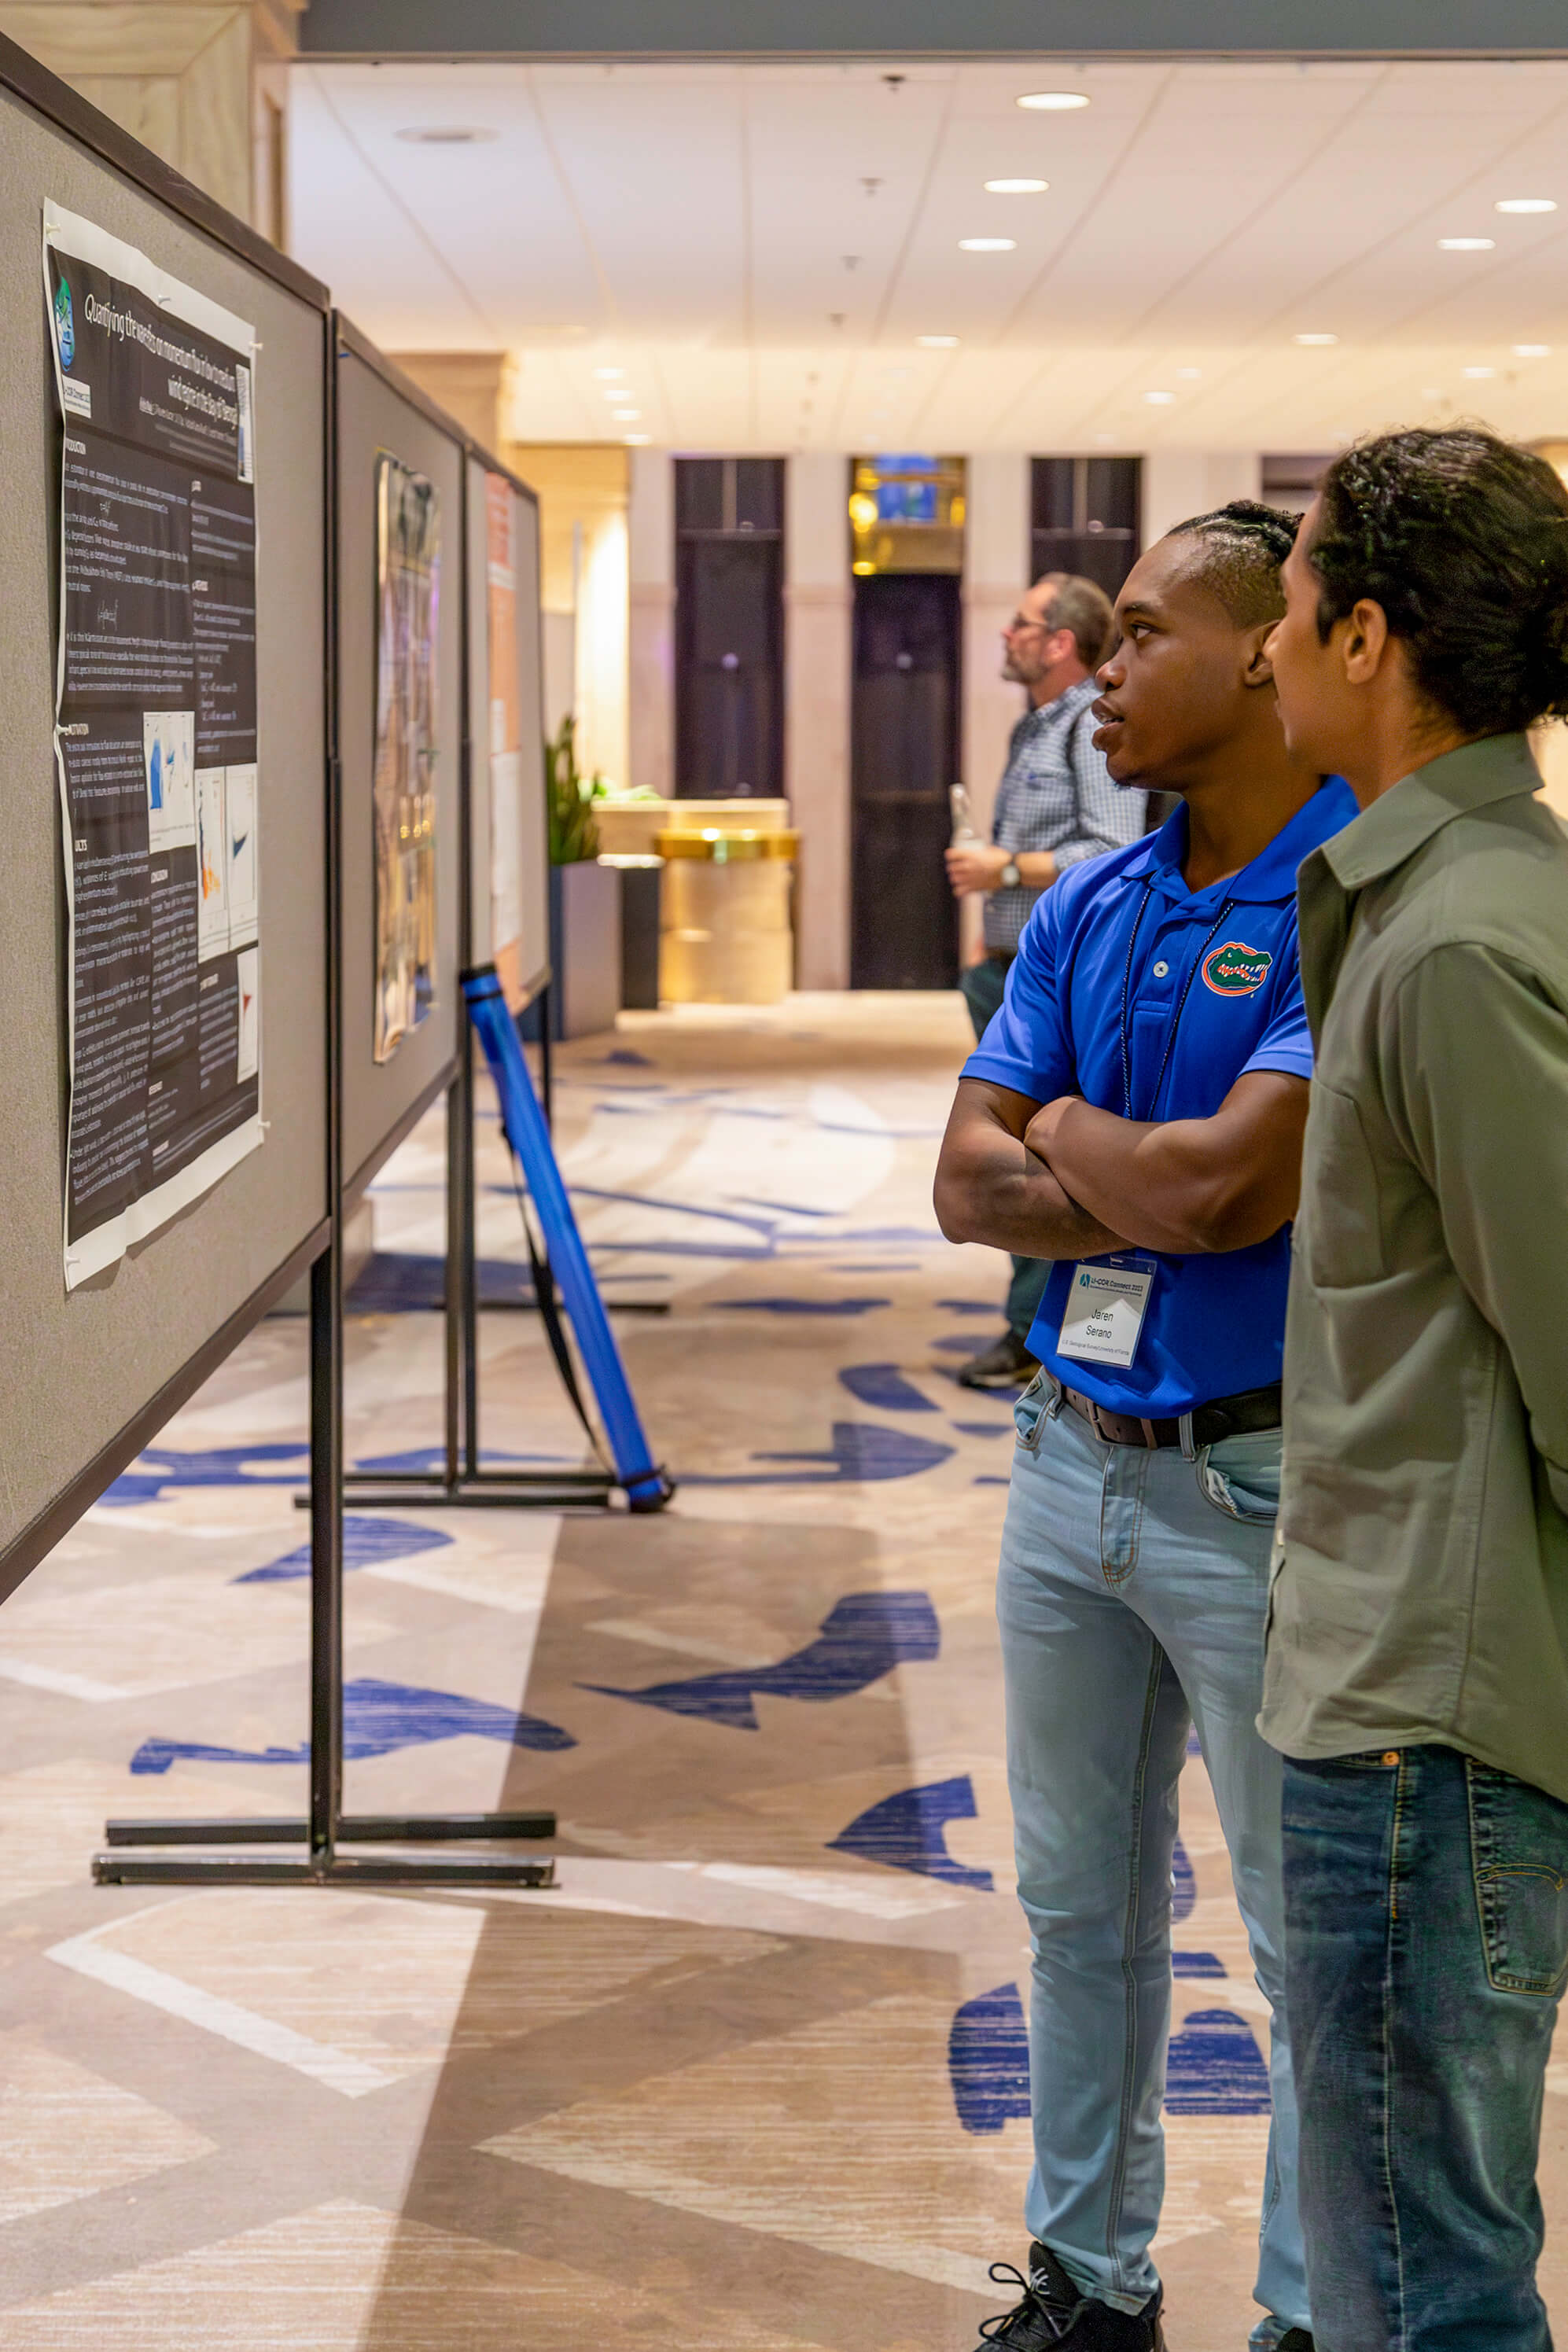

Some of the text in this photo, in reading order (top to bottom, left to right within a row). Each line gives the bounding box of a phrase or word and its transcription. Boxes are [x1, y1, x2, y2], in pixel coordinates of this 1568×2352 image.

[85, 293, 125, 341] Quantifying
[1091, 1309, 1113, 1322] Jaren
[1086, 1325, 1112, 1339] Serano
